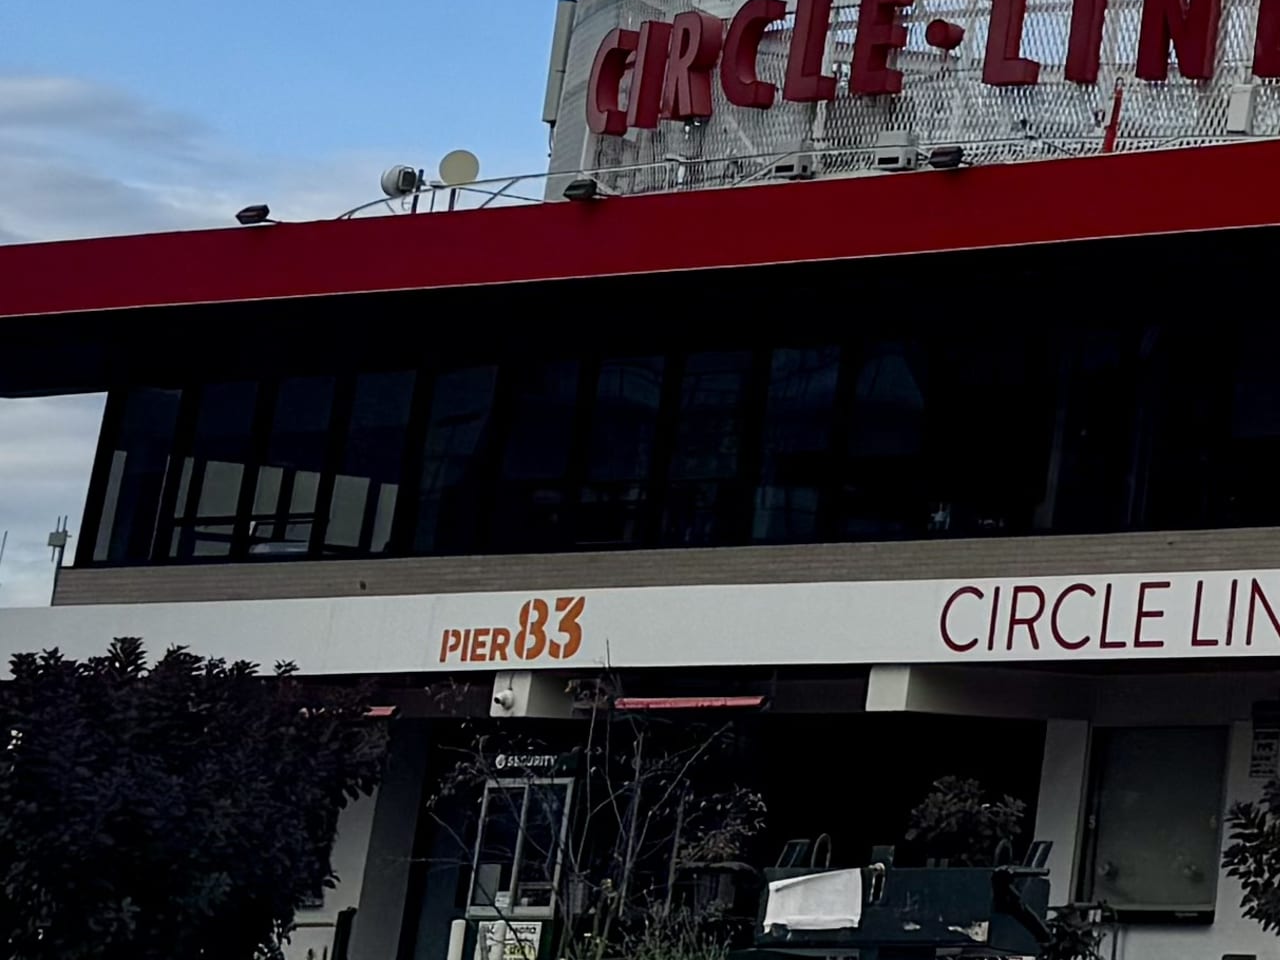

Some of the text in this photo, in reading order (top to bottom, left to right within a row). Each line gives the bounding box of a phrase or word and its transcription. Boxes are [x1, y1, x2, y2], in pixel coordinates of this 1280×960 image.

[439, 595, 586, 663] PIER 83
[939, 581, 1171, 653] CIRCLE
[506, 754, 558, 768] SECURITY
